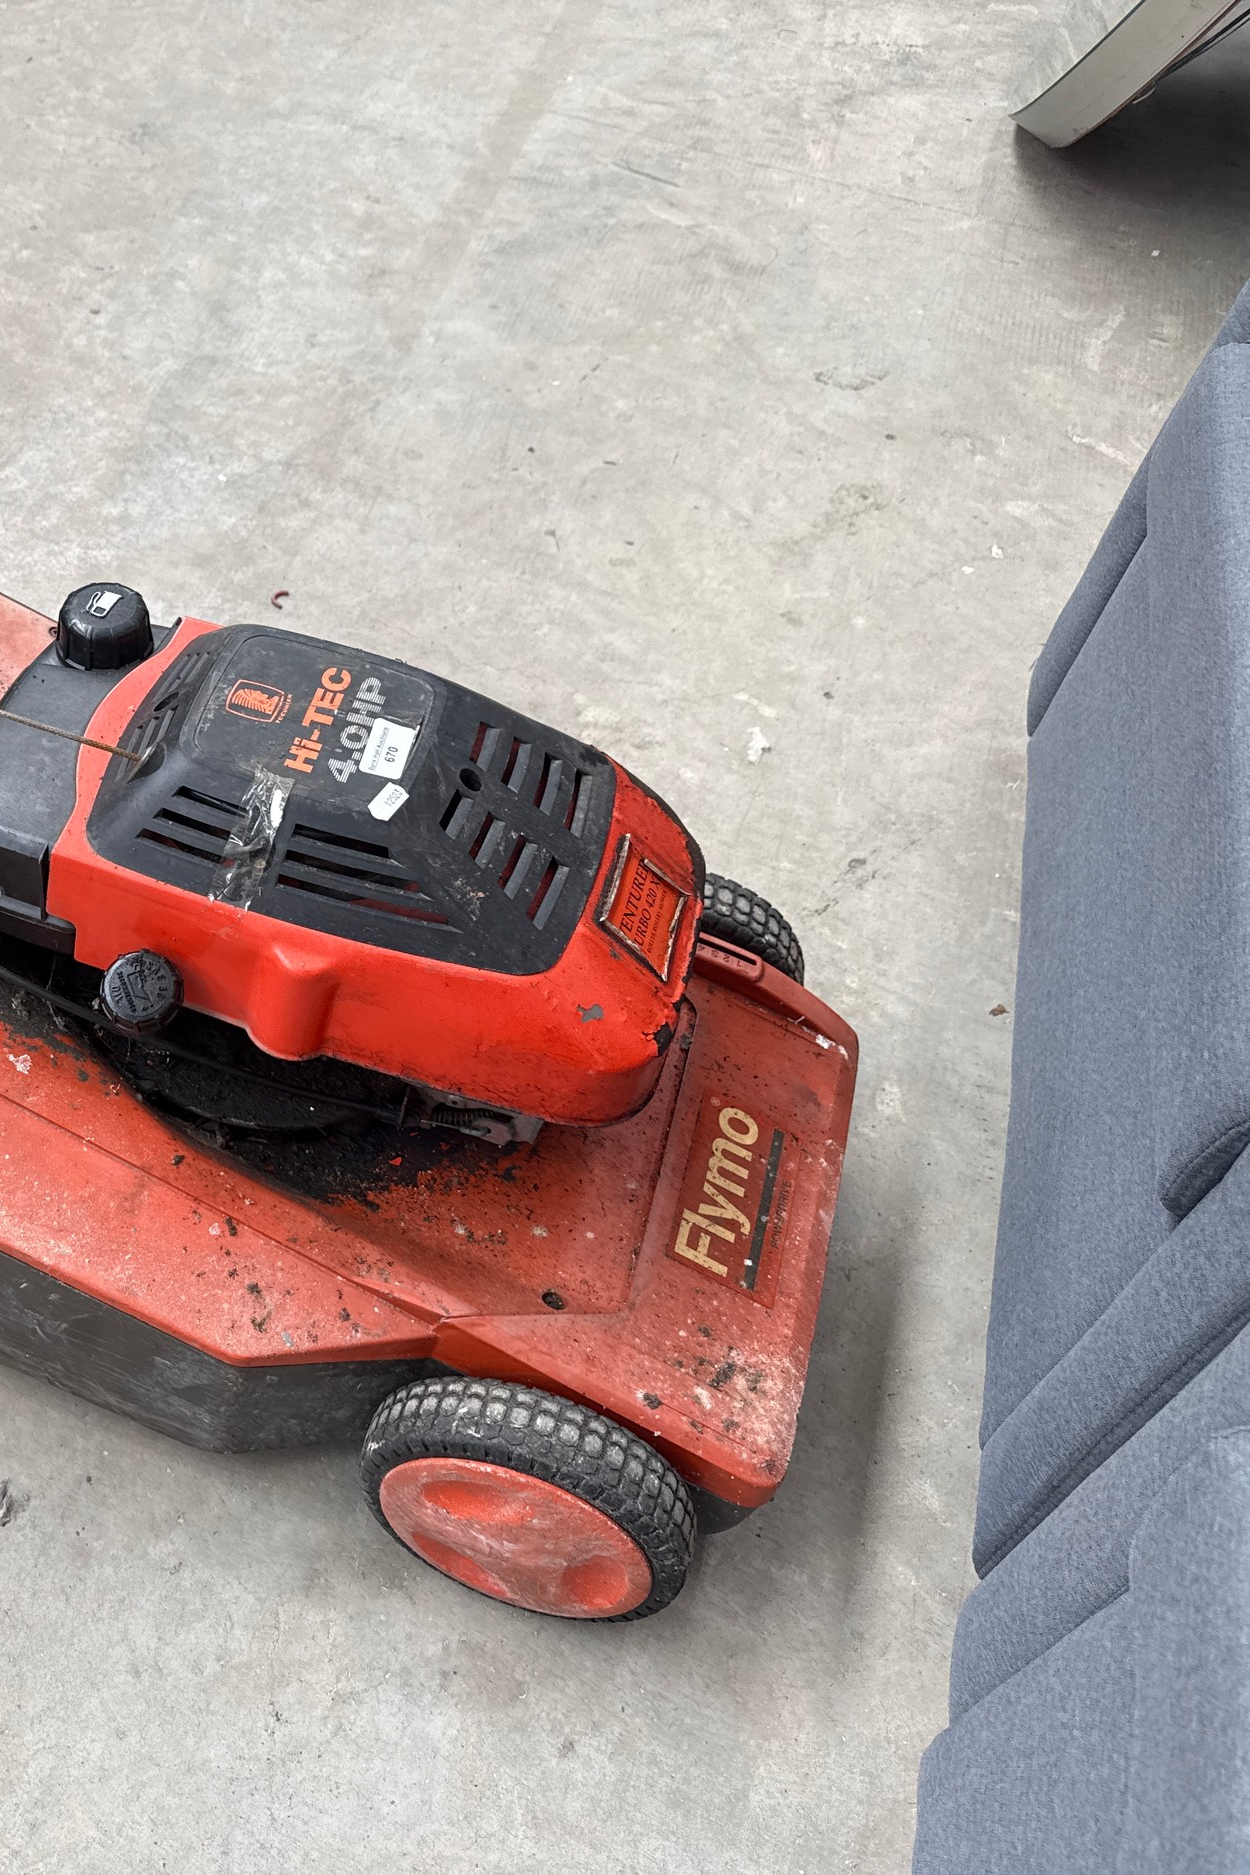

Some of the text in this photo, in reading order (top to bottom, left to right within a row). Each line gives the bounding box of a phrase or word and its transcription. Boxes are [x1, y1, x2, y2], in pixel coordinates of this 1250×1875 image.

[283, 667, 352, 773] Hi-TEC
[384, 746, 398, 763] 670
[384, 788, 403, 807] 12523
[644, 887, 657, 908] 420
[674, 1107, 759, 1277] Flymo
